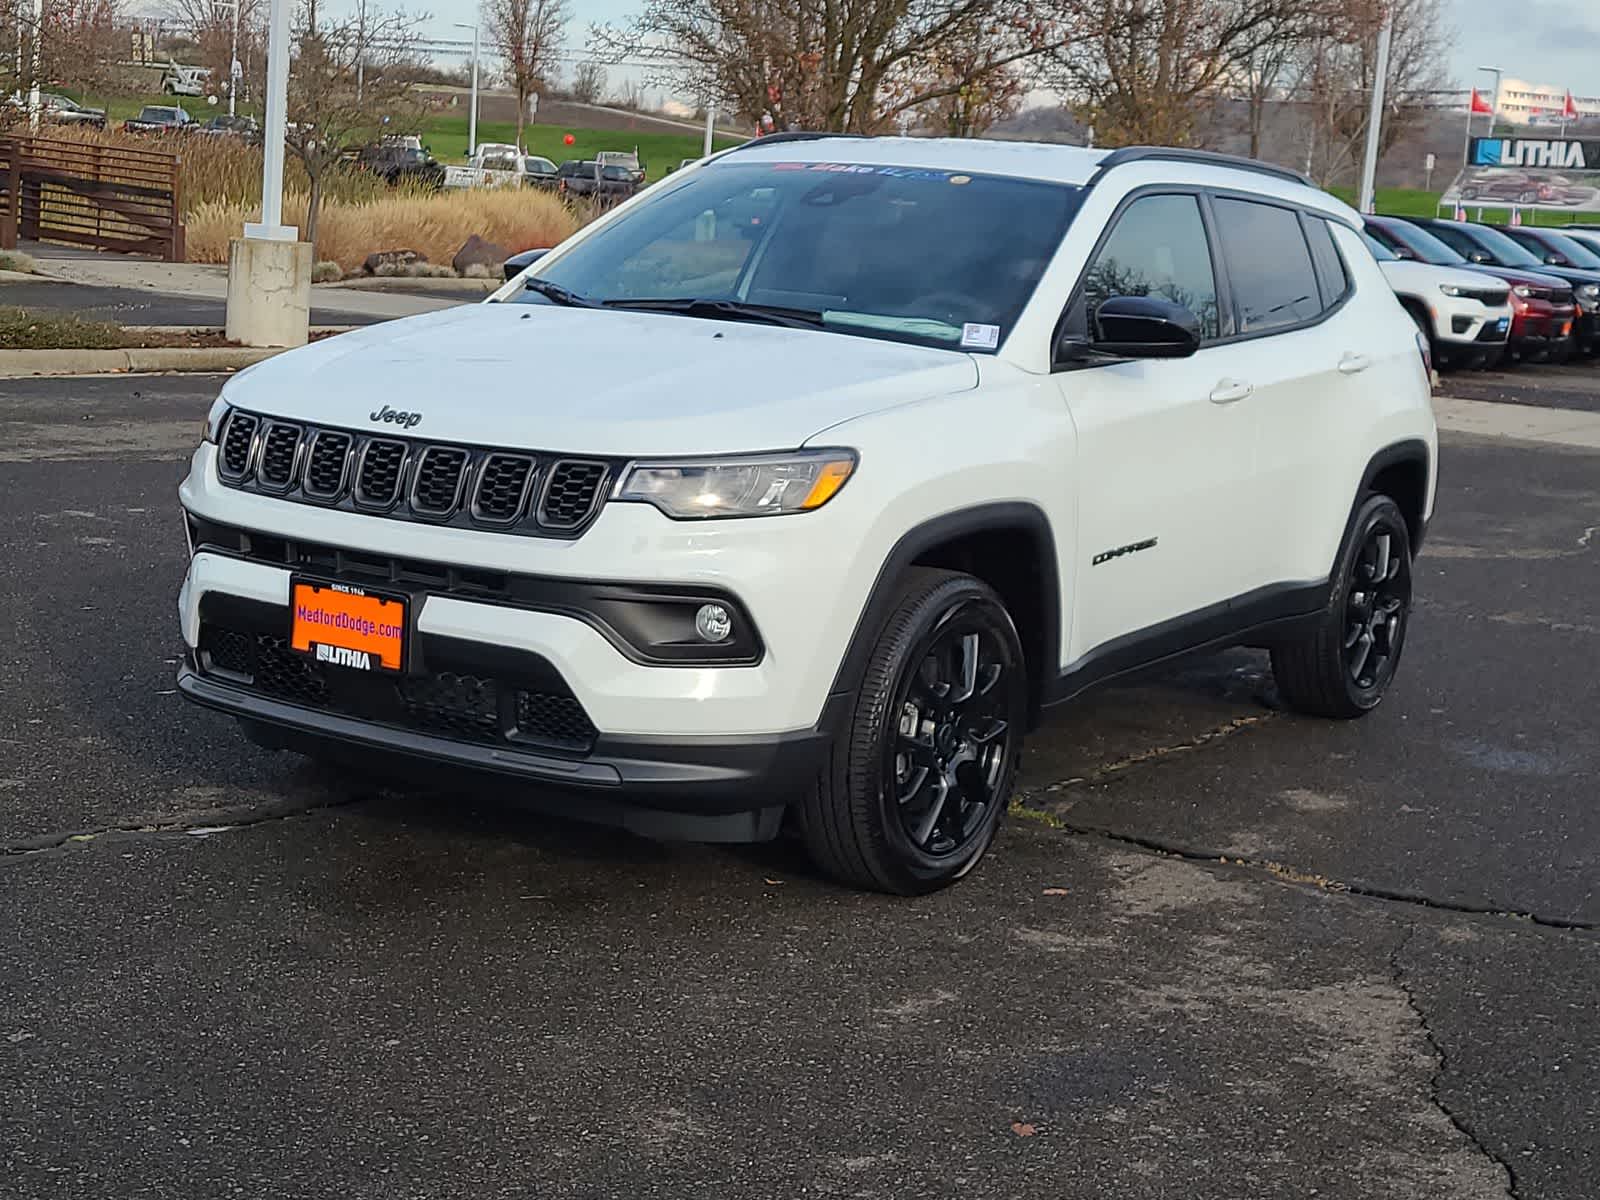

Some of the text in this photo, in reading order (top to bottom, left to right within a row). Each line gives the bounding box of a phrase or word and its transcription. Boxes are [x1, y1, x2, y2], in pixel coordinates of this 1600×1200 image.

[1500, 139, 1586, 168] LITHIA
[369, 404, 422, 429] Jeep
[331, 583, 349, 593] SINCE
[298, 604, 403, 640] MedfordDodge.com
[329, 645, 371, 671] LITHIA
